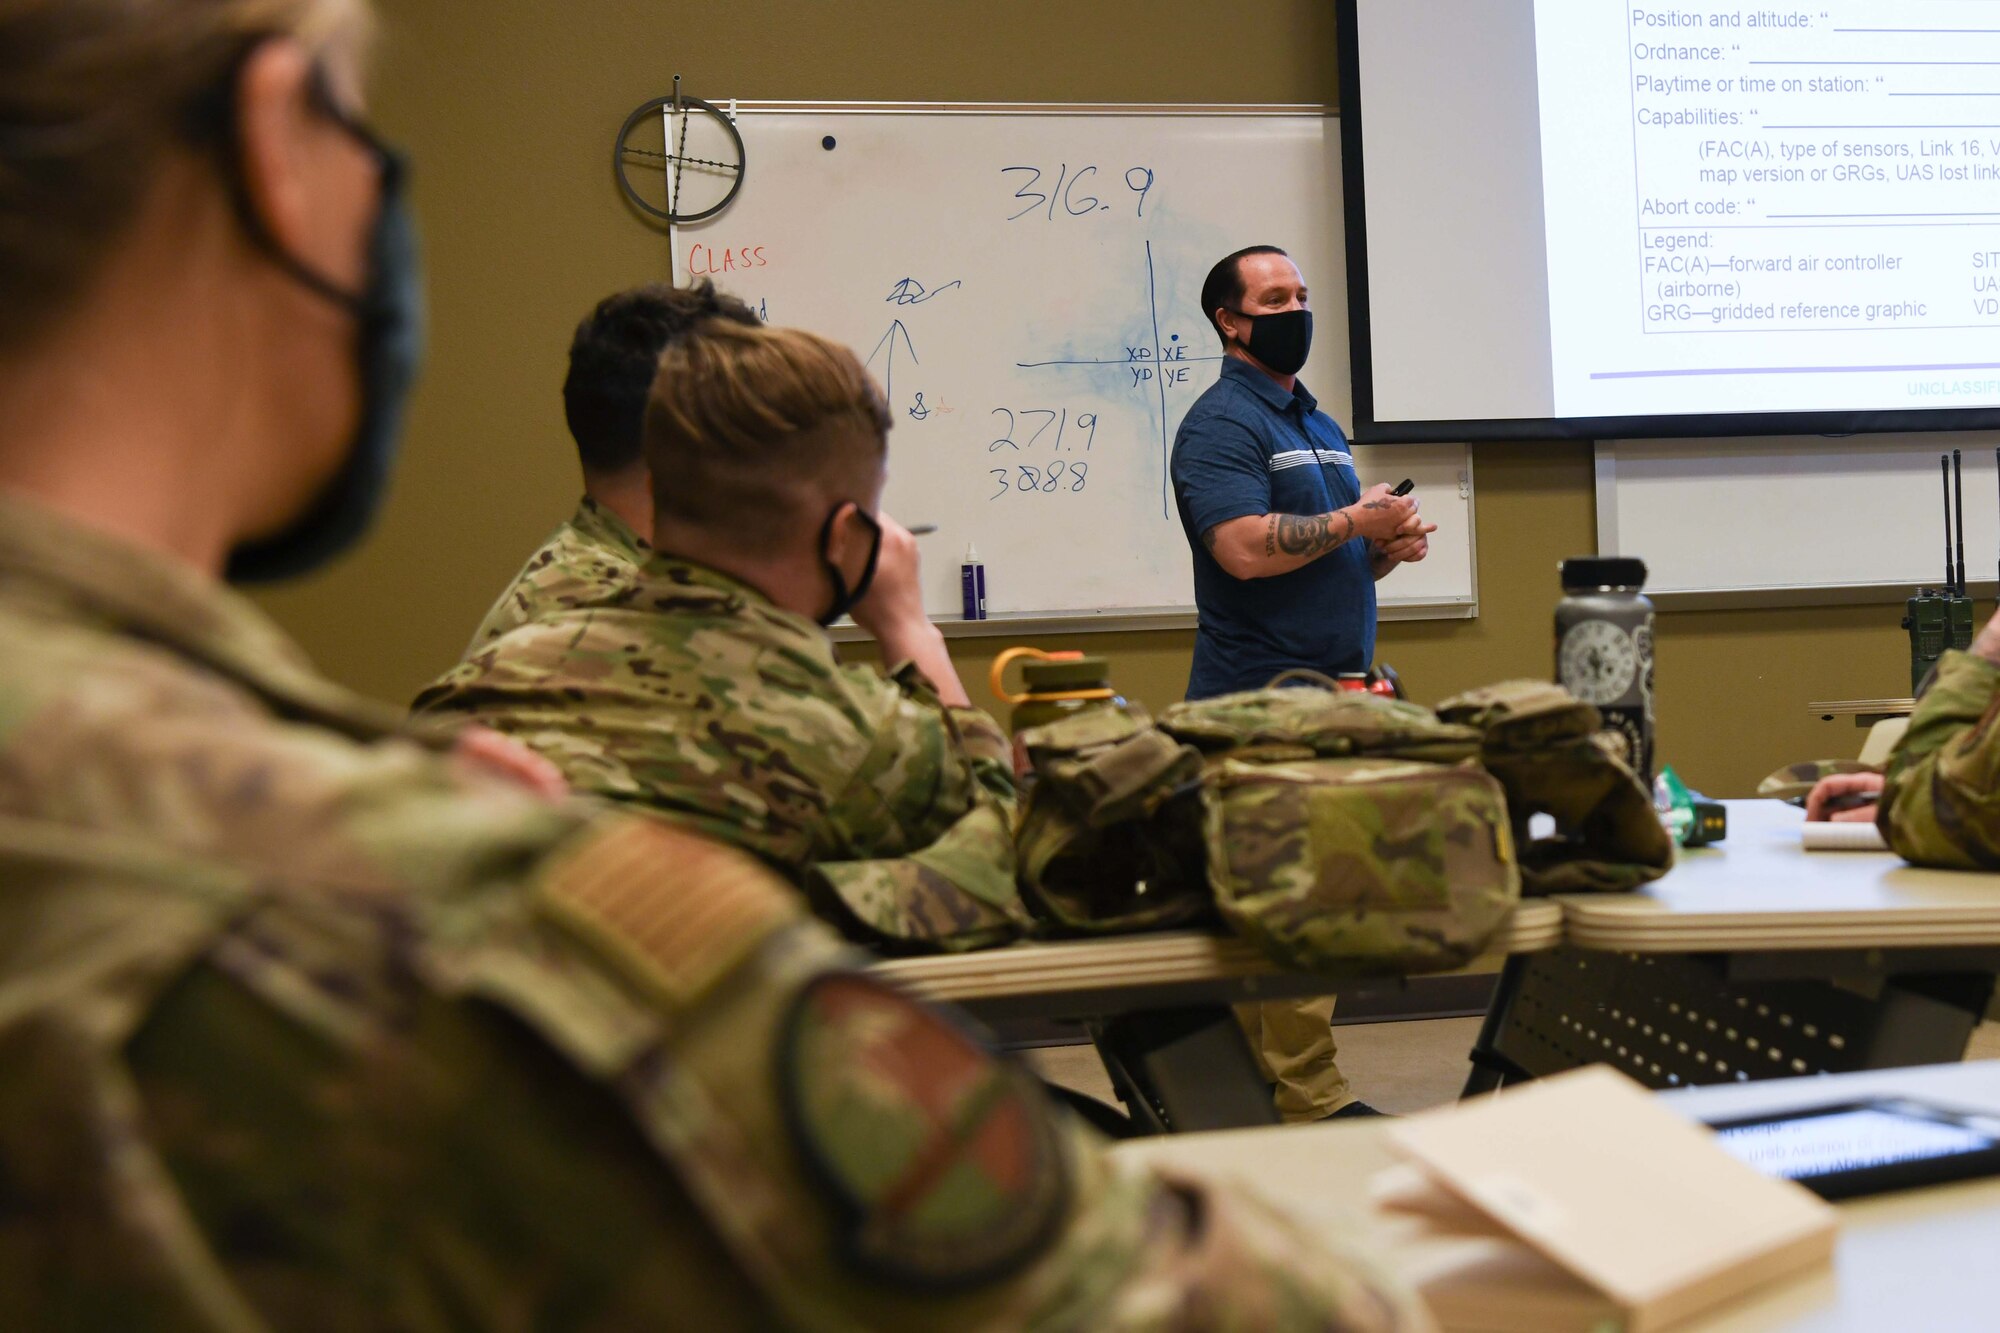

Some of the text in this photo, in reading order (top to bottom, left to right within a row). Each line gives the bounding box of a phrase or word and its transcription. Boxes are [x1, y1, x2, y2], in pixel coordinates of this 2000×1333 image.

[1632, 9, 1703, 28] Position
[1708, 10, 1741, 27] and
[1746, 10, 1814, 29] altitude:
[1633, 42, 1726, 61] Ordnance:
[1635, 75, 1712, 96] Playtime
[1716, 79, 1734, 93] or
[1738, 73, 1776, 93] time
[1780, 79, 1803, 93] on
[1807, 75, 1870, 94] station:
[1637, 107, 1744, 129] Capabilities:
[1698, 140, 1775, 162] (FAC(A),
[1780, 141, 1817, 161] type
[1821, 140, 1839, 158] of
[1843, 143, 1914, 160] sensors,
[1920, 139, 1955, 157] Link
[1699, 168, 1738, 186] map
[1742, 165, 1805, 182] version
[1809, 168, 1828, 182] or
[1832, 164, 1890, 184] GRGs,
[1896, 163, 1935, 181] UAS
[1939, 163, 1969, 181] lost
[1001, 163, 1154, 221] 316.9
[1641, 198, 1690, 216] Abort
[1693, 197, 1741, 215] code:
[1643, 231, 1713, 253] Legend:
[689, 243, 768, 275] CLASS
[1797, 254, 1820, 272] air
[1824, 252, 1904, 272] controller
[1657, 279, 1741, 301] (airborne)
[1973, 275, 2000, 293] UA
[1780, 301, 1861, 320] reference
[1865, 299, 1928, 321] graphic
[1162, 345, 1189, 361] XE
[989, 407, 1097, 452] 271.9
